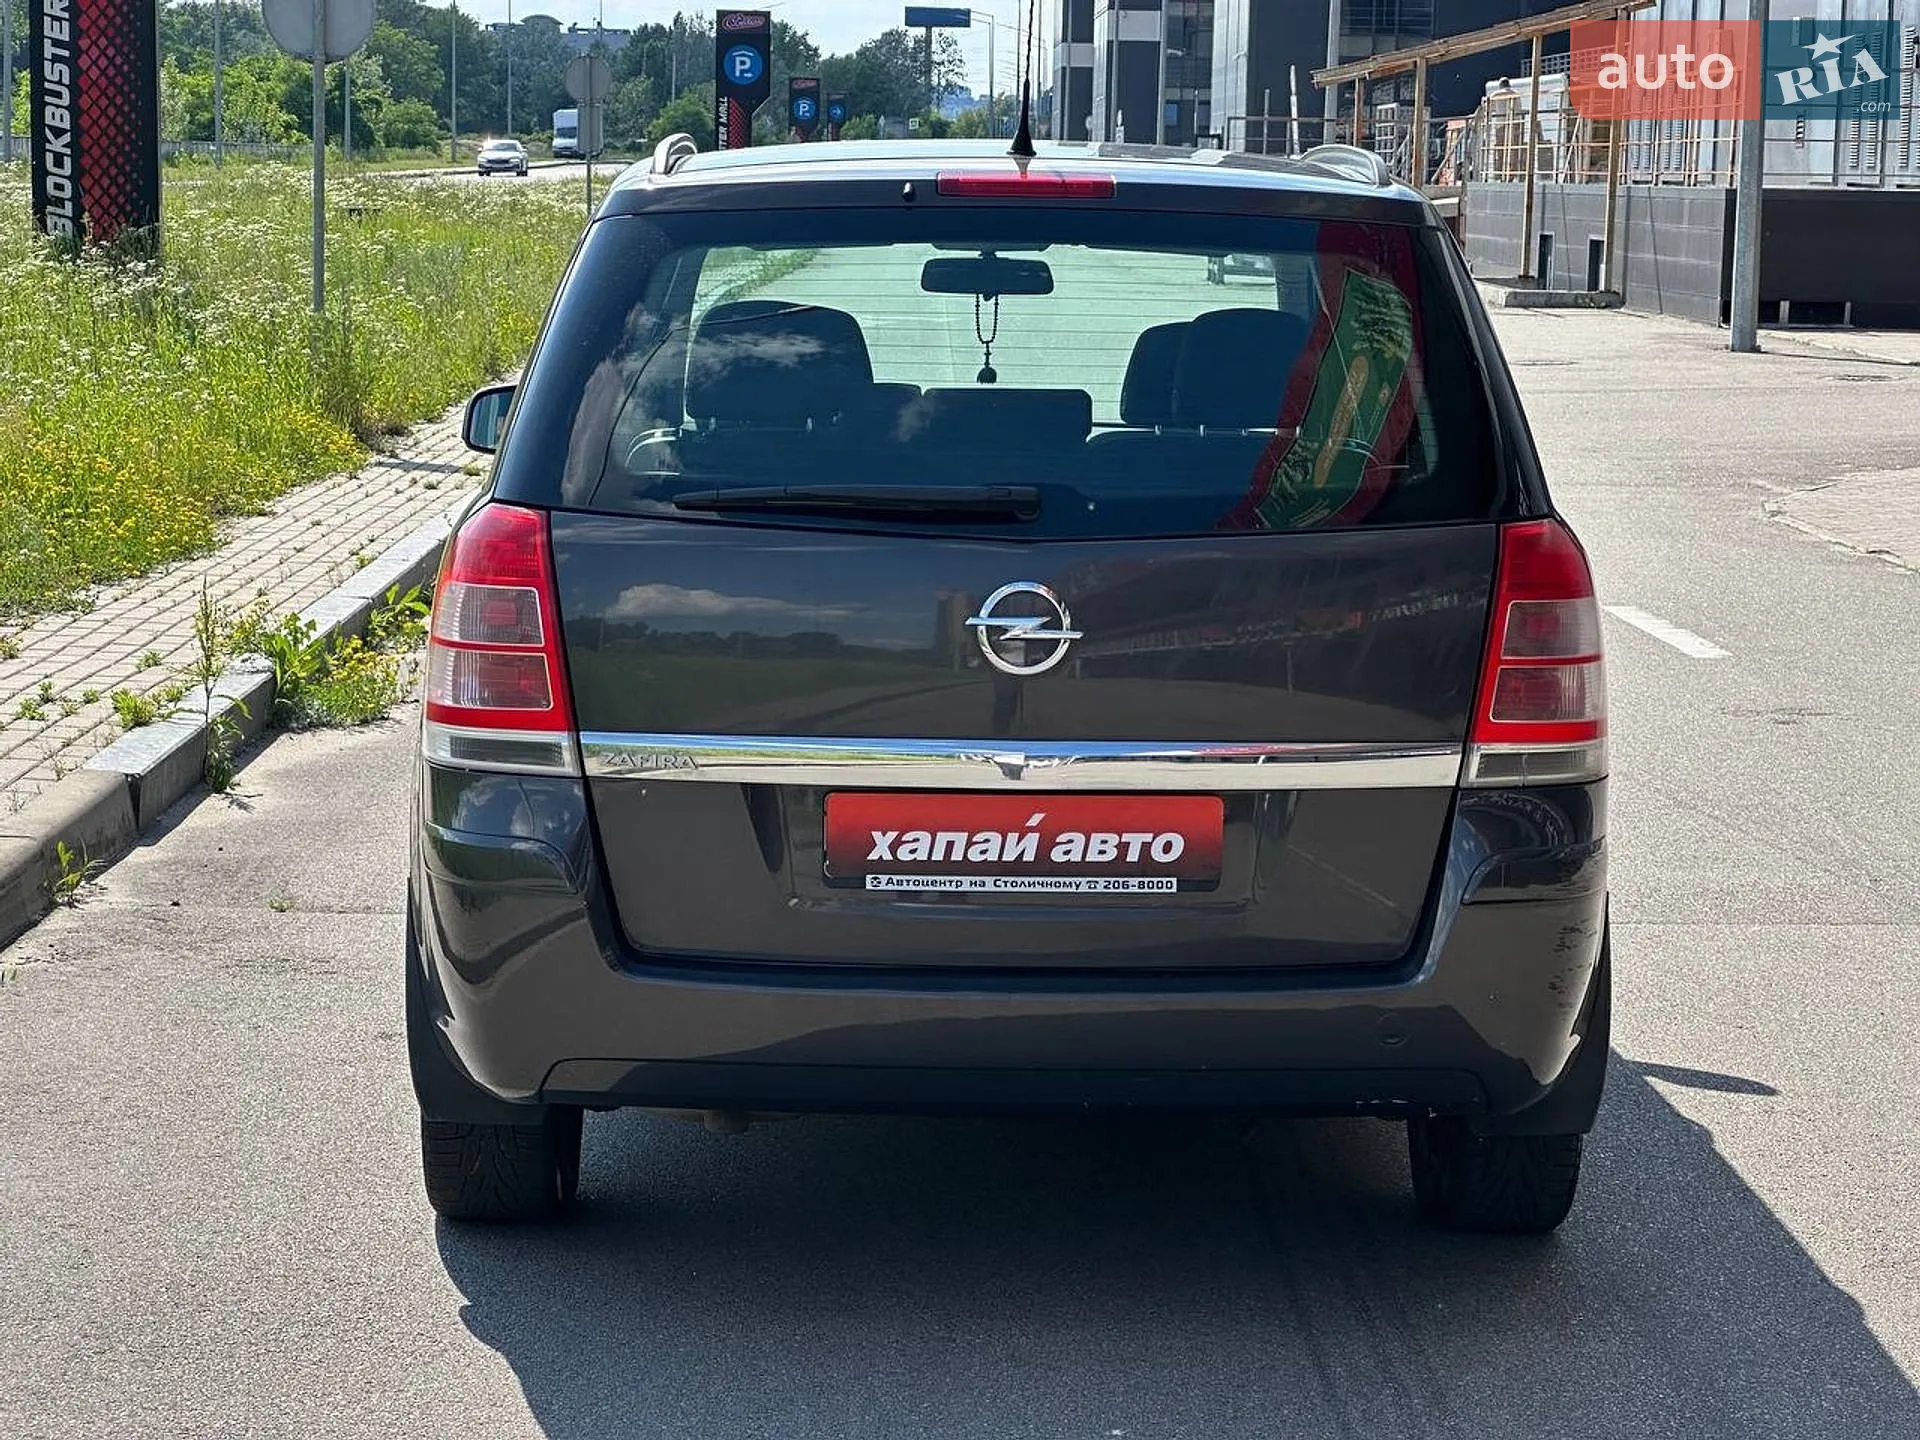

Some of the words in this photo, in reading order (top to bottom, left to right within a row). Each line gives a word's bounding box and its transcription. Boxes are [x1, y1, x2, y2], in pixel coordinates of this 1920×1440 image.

[602, 752, 698, 769] ZAFIRA
[1050, 832, 1185, 863] авто
[885, 876, 963, 888] Автоцентр
[969, 879, 986, 887] на
[993, 878, 1082, 891] Столичному
[1103, 880, 1174, 890] 206-8000
